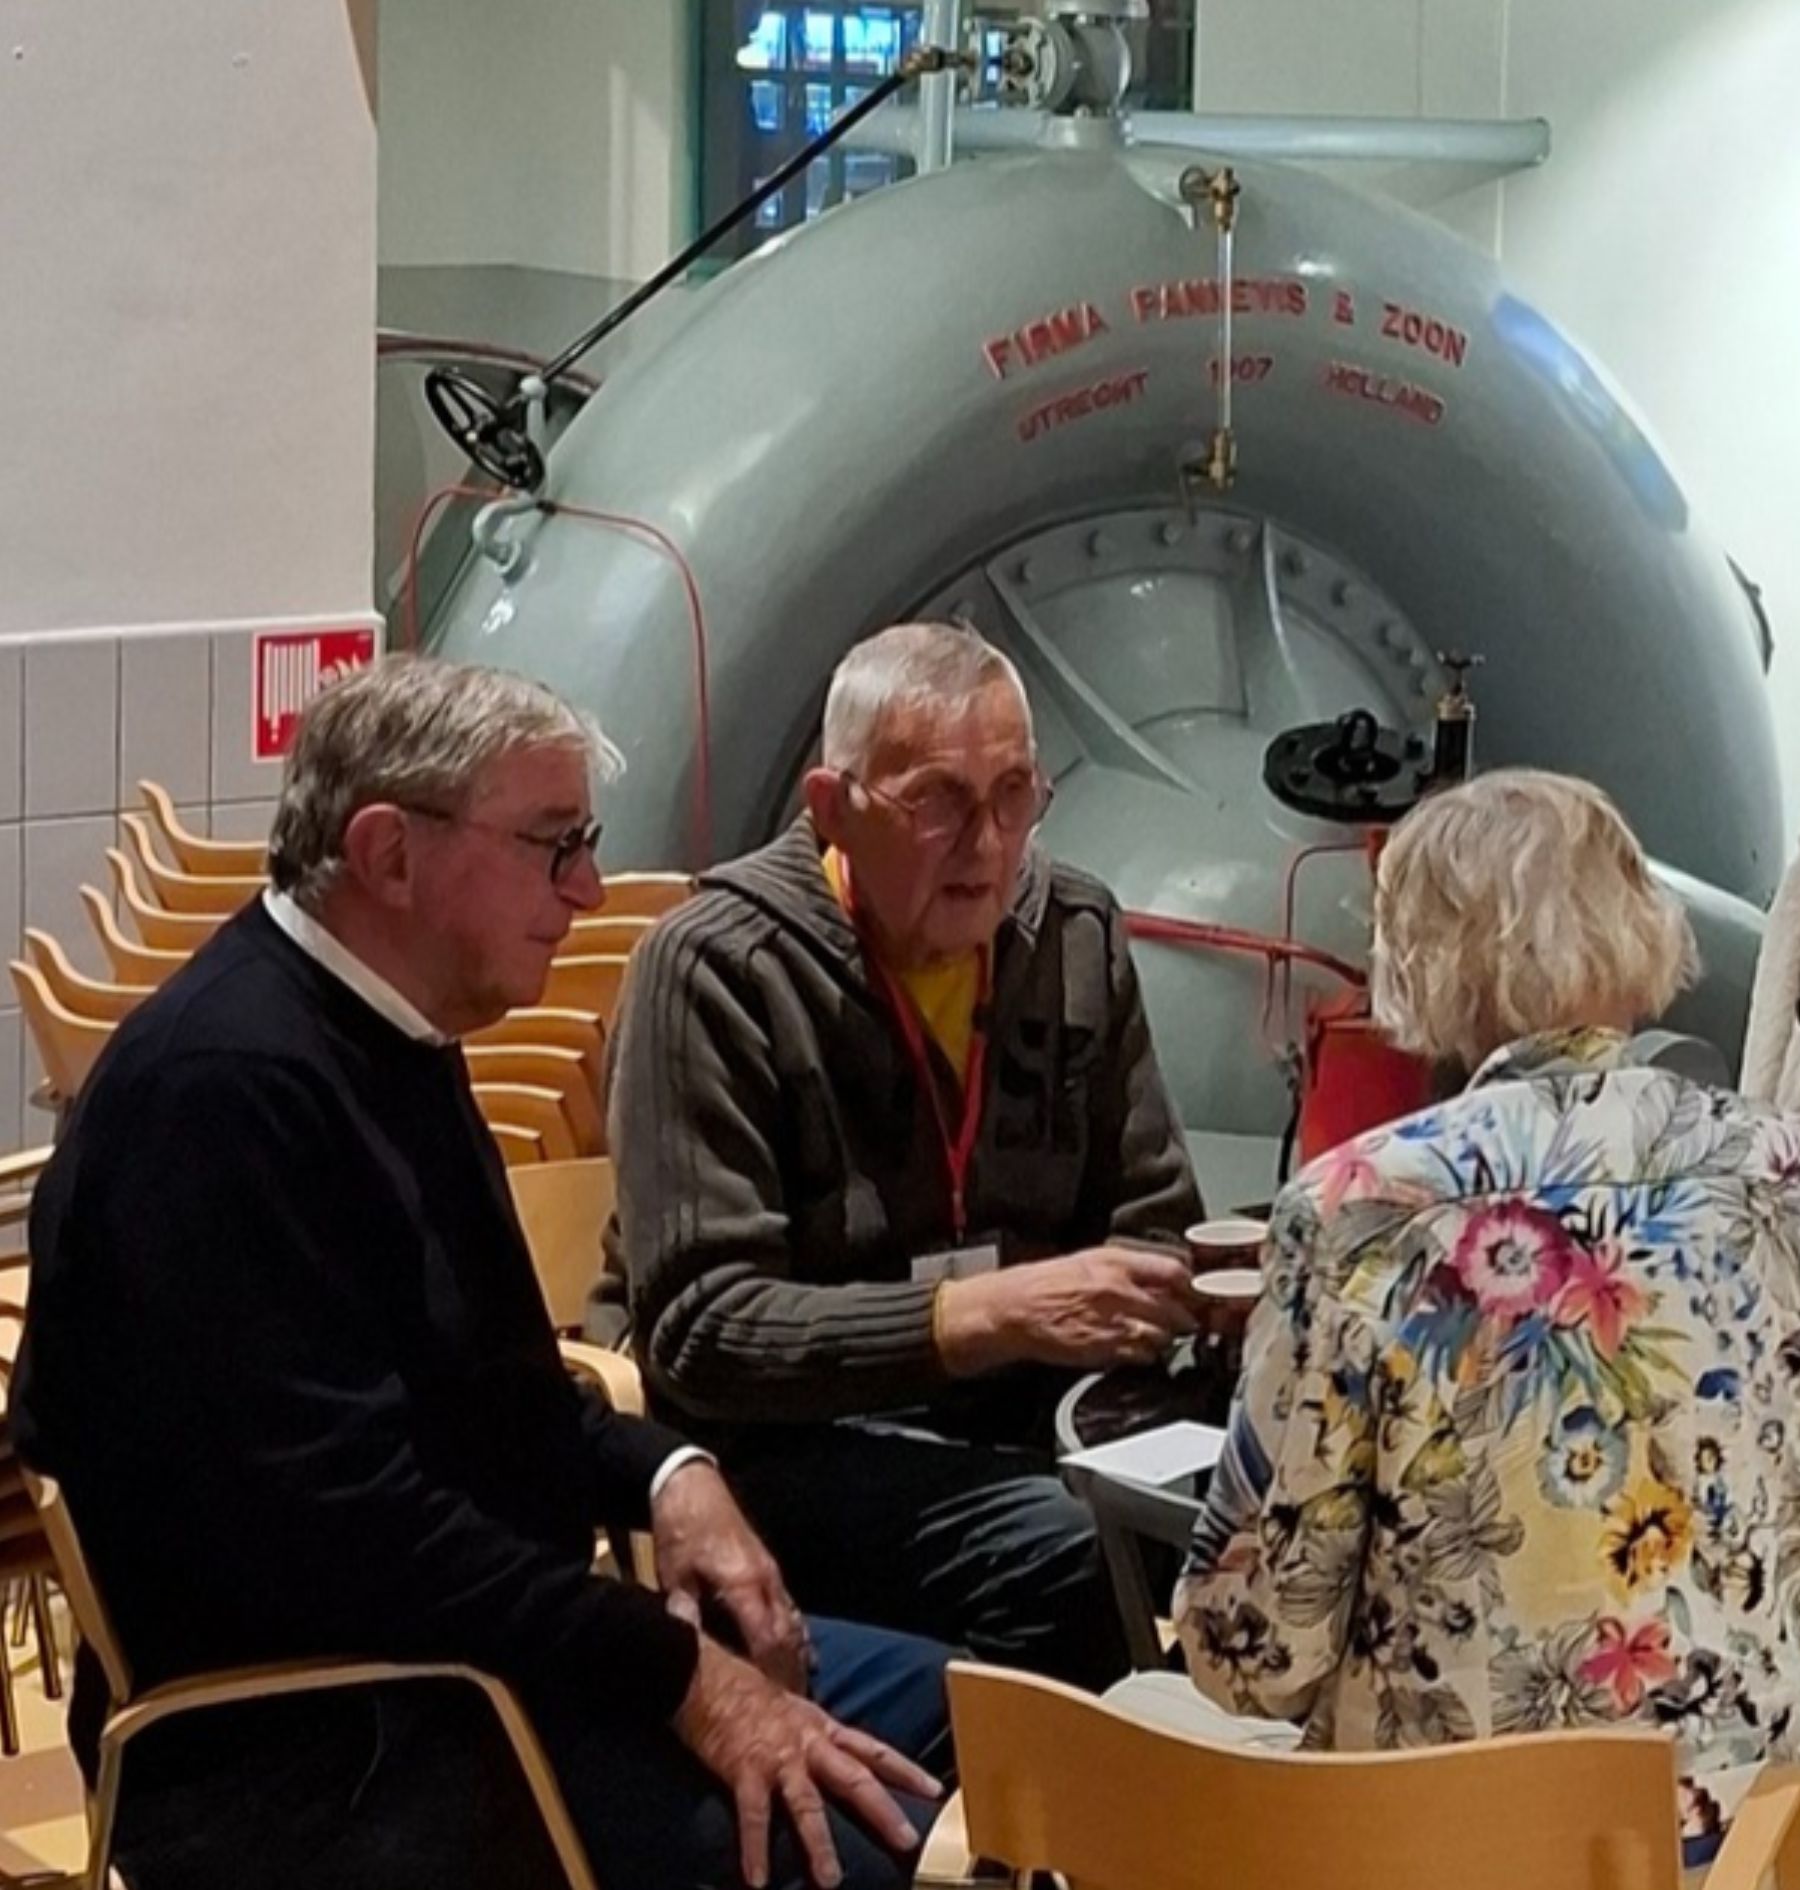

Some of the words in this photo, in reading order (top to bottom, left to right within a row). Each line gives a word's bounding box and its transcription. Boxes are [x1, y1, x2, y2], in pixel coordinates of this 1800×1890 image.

[983, 301, 1109, 379] FIRMA
[1332, 289, 1355, 326] &
[1381, 301, 1467, 367] ZOON
[1017, 368, 1148, 442] UTRECHT
[1325, 363, 1445, 424] HOLLAND
